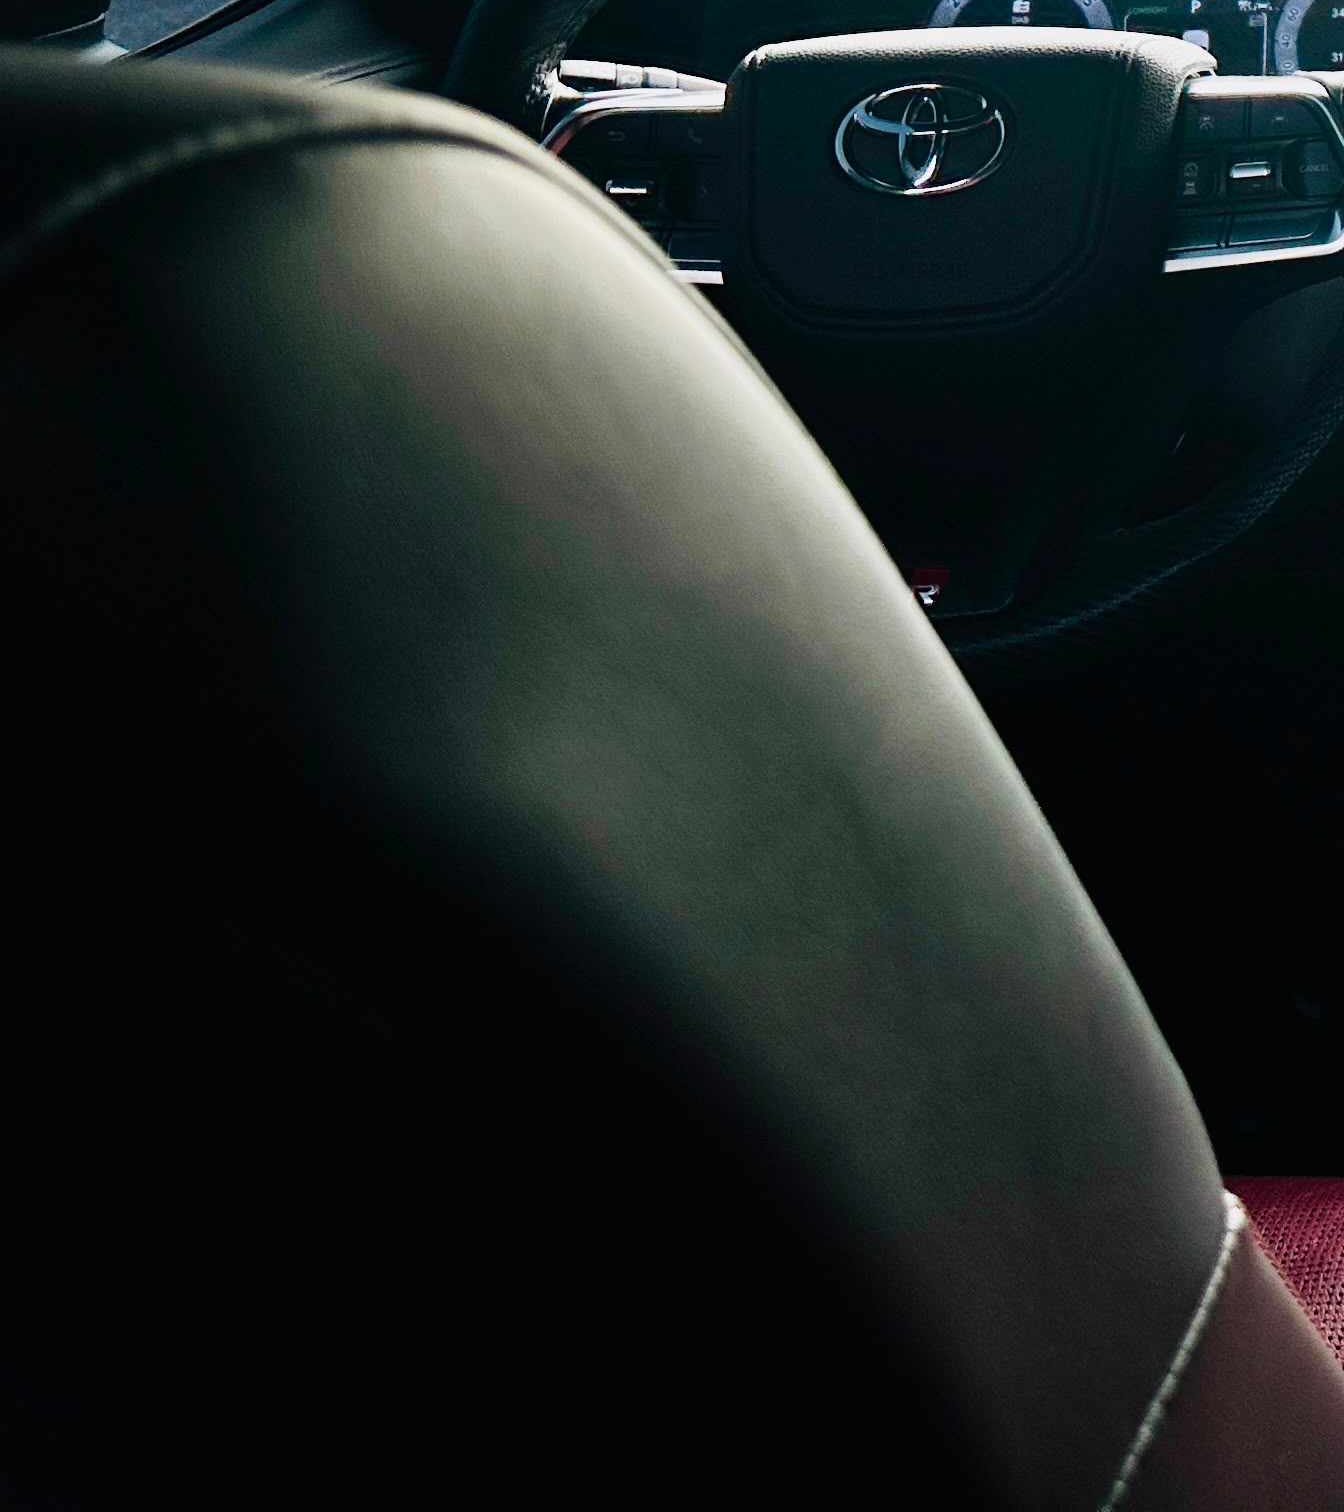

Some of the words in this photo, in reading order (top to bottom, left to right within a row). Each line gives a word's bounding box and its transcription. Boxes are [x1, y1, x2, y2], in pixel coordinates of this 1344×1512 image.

[1190, 0, 1202, 14] P
[1331, 7, 1344, 19] 34
[1286, 7, 1300, 23] 60
[1281, 33, 1291, 48] 40
[1331, 52, 1344, 63] 31
